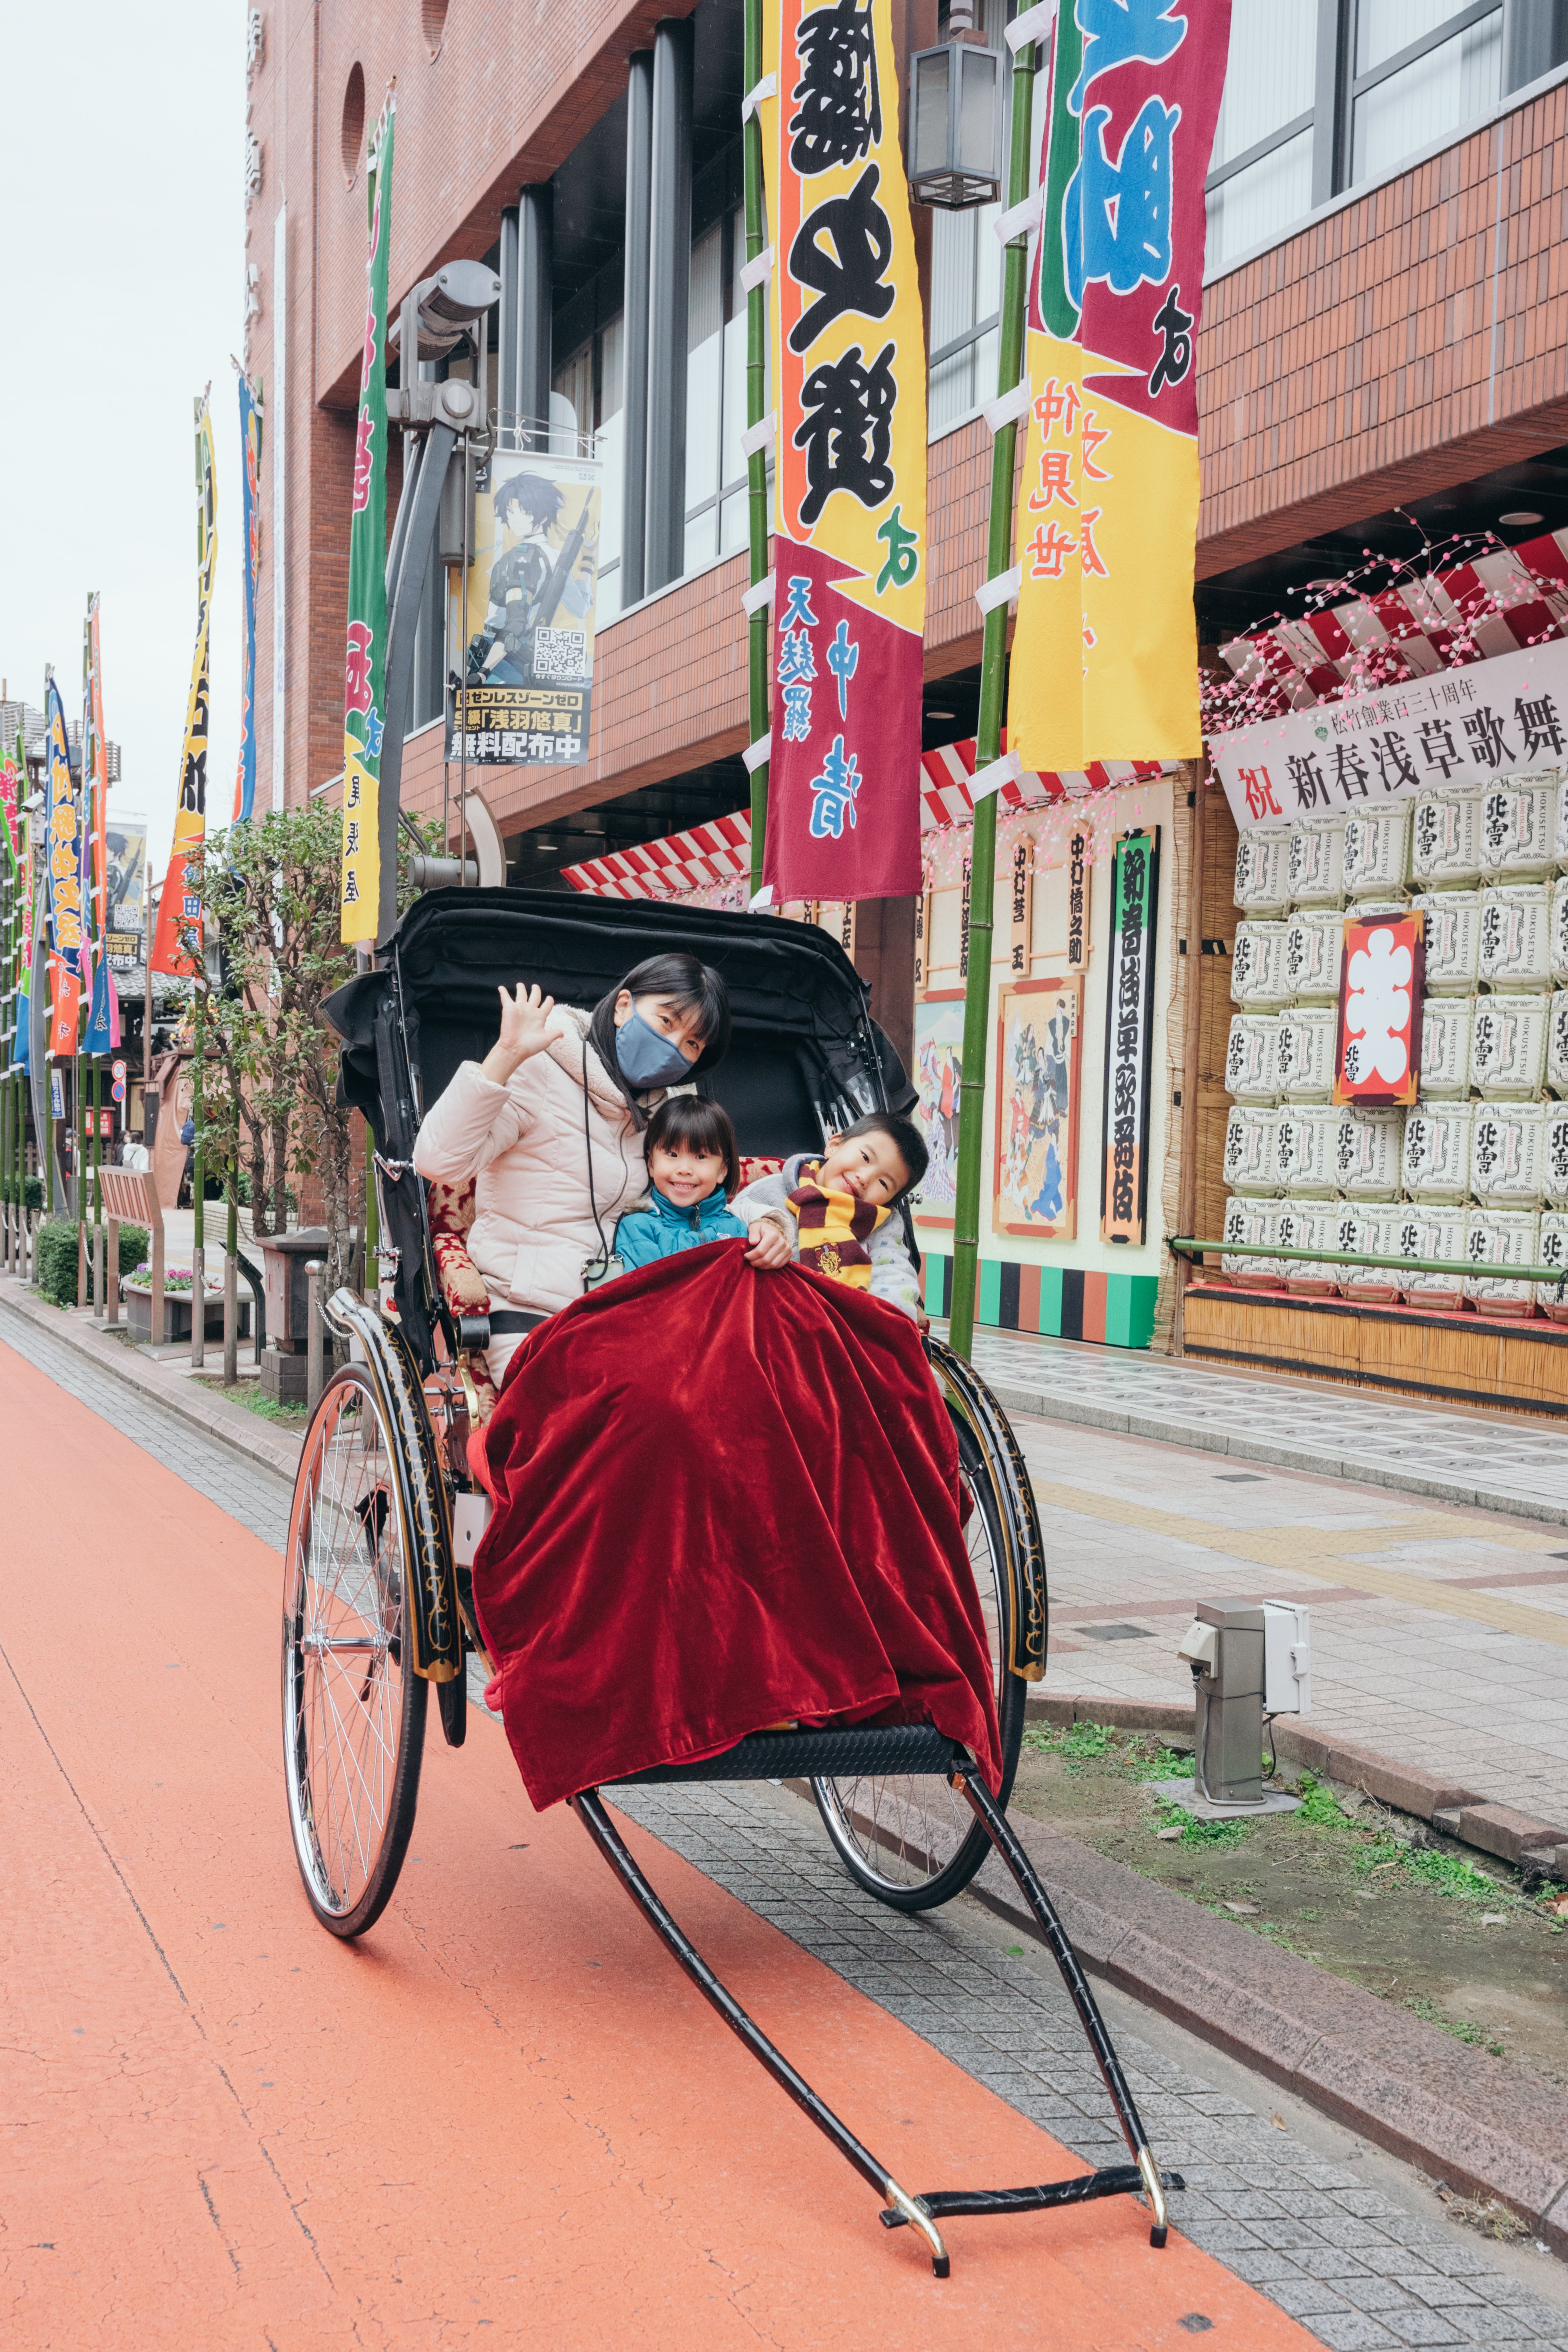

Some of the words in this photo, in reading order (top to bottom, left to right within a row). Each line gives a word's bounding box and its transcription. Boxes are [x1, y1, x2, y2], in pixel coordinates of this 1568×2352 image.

[471, 692, 579, 706] ゼンレスゾーンゼロ
[1330, 678, 1477, 736] 松竹創業百三十周年
[450, 731, 581, 759] 無料配布中
[1238, 765, 1282, 820] 祝
[1418, 805, 1437, 857] 北雪
[1486, 794, 1509, 847] 北雪
[1538, 792, 1546, 850] HOKUSETSU
[1237, 844, 1250, 889] 北雪
[1271, 844, 1280, 894] HOKUSETSU
[1289, 836, 1301, 880] 北雪
[1323, 833, 1332, 884] HOKUSETSU
[1344, 822, 1358, 872] 北雪
[1381, 820, 1390, 873] HOKUSETSU
[1287, 929, 1304, 975] 北雪
[1461, 912, 1469, 968] HOKUSETSU
[1482, 906, 1501, 959] 北雪
[1527, 907, 1537, 966] HOKUSETSU
[1235, 937, 1251, 982] 北雪
[1272, 939, 1282, 989] HOKUSETSU
[1229, 1032, 1245, 1076] 北雪
[1266, 1035, 1275, 1085] HOKUSETSU
[1278, 1028, 1293, 1074] 北雪
[1316, 1028, 1324, 1080] HOKUSETSU
[1448, 1019, 1458, 1075] HOKUSETSU
[1475, 1015, 1493, 1066] 北雪
[1519, 1017, 1530, 1075] HOKUSETSU
[115, 1066, 123, 1075] 30
[1227, 1124, 1243, 1166] 北雪
[1264, 1126, 1274, 1175] HOKUSETSU
[1278, 1123, 1293, 1168] 北雪
[1337, 1124, 1354, 1170] 北雪
[1378, 1124, 1387, 1177] HOKUSETSU
[1407, 1120, 1427, 1169] 北雪
[1451, 1122, 1461, 1177] HOKUSETSU
[1476, 1122, 1498, 1175] 北雪
[1525, 1125, 1535, 1183] HOKUSETSU
